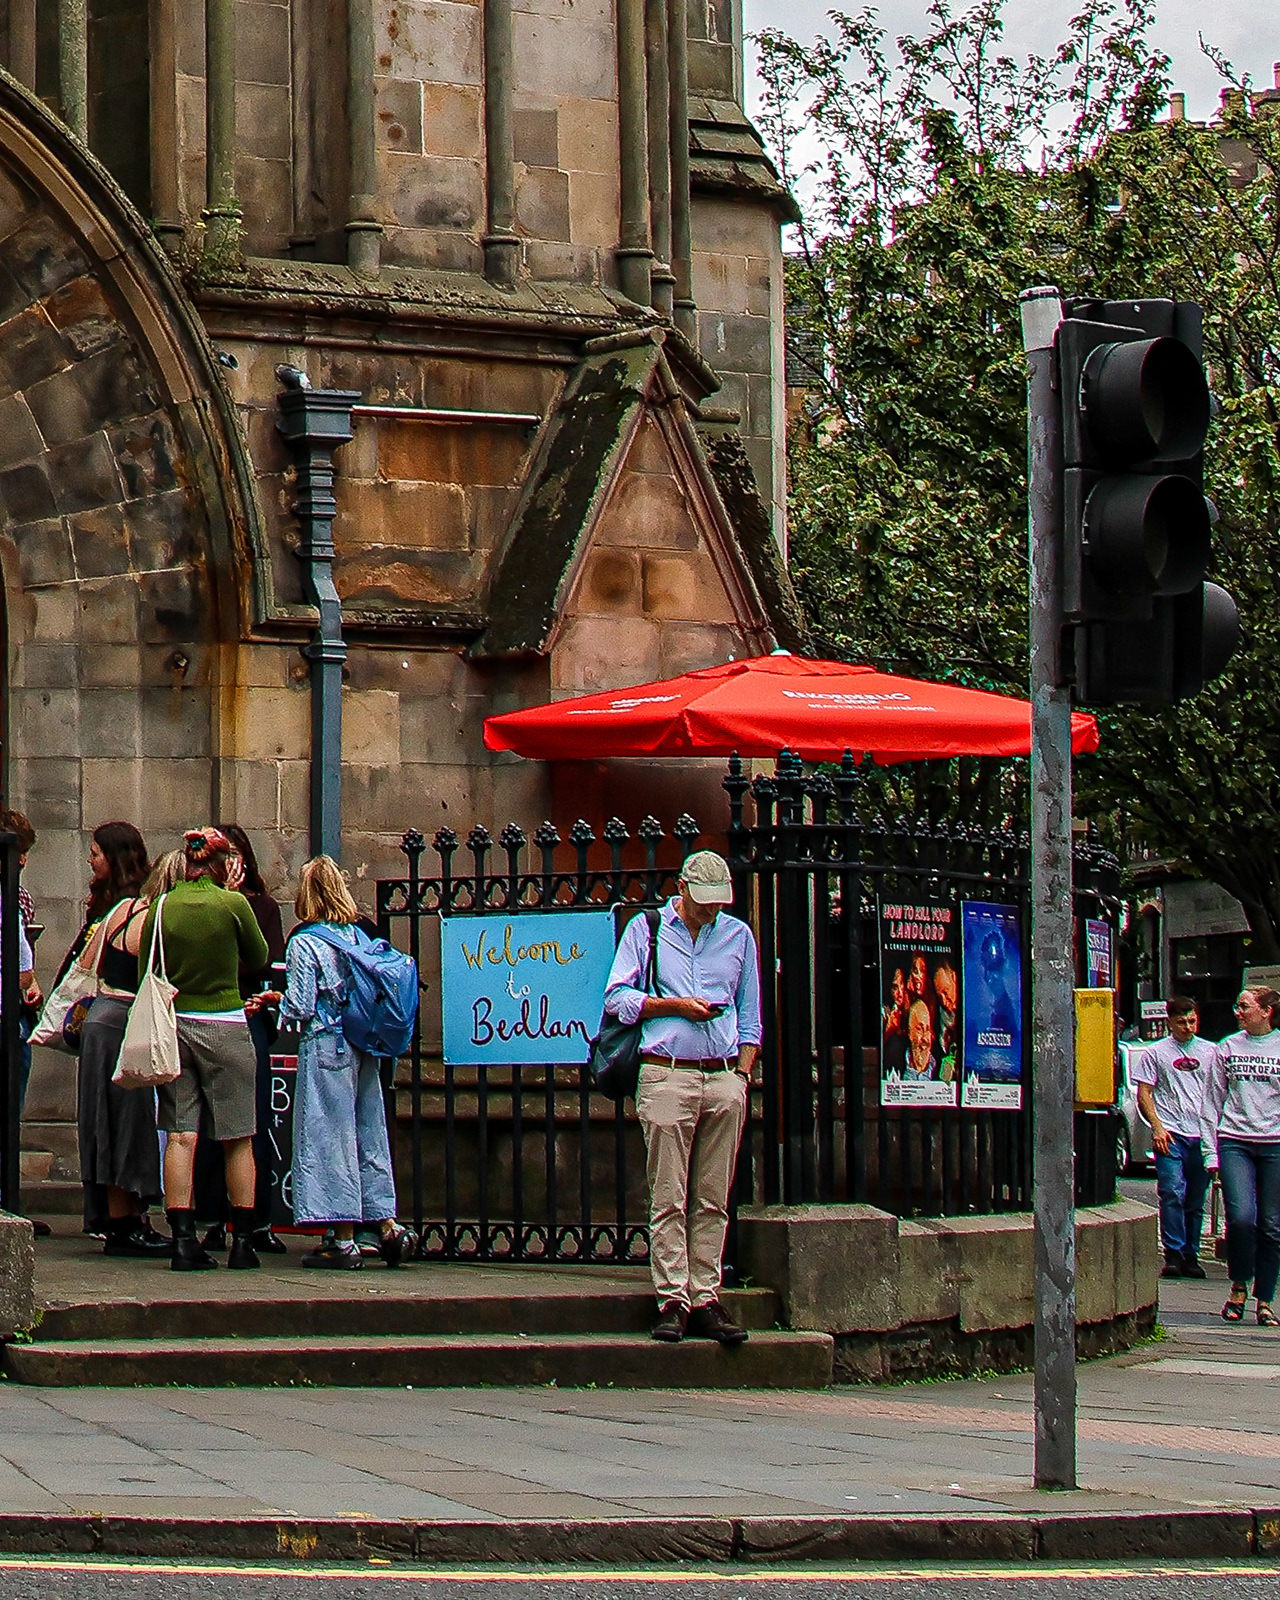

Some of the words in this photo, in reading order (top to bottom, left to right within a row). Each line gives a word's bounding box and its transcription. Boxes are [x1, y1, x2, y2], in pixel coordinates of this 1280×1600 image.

[883, 904, 903, 919] HOW
[903, 904, 914, 920] TO
[914, 905, 931, 921] KILL
[931, 906, 951, 922] YOUR
[890, 921, 946, 941] LANDLORD
[462, 924, 587, 970] Welcome
[505, 971, 531, 999] to
[470, 993, 593, 1045] Bedlam
[1258, 1065, 1270, 1074] OF
